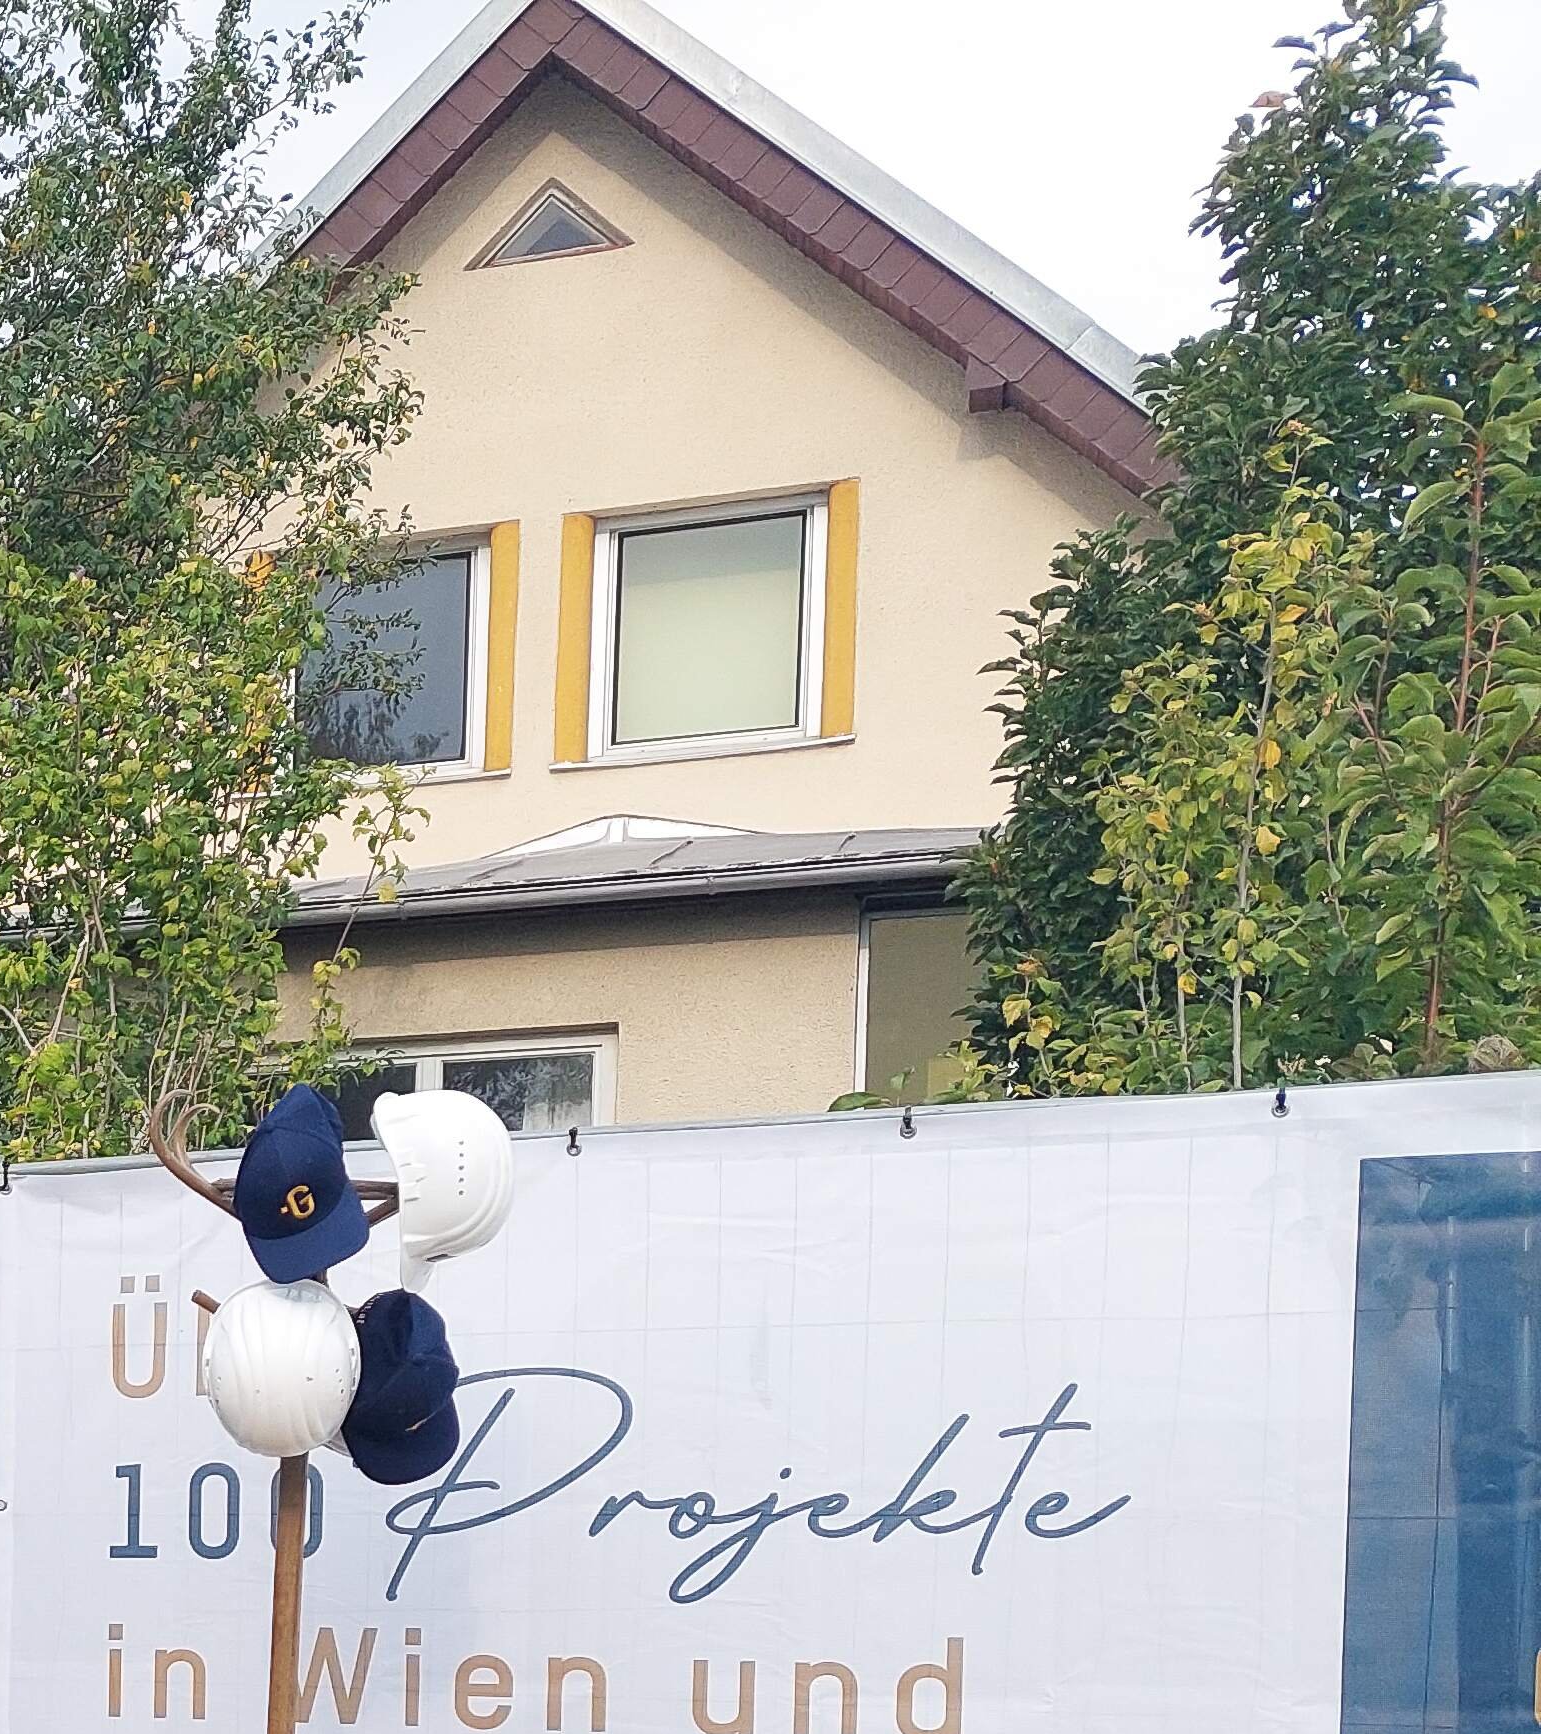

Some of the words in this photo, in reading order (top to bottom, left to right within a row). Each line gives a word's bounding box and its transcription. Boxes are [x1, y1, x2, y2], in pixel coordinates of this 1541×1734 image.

[385, 1366, 1133, 1604] Projekte
[108, 1623, 207, 1721] in
[292, 1627, 608, 1733] Wien
